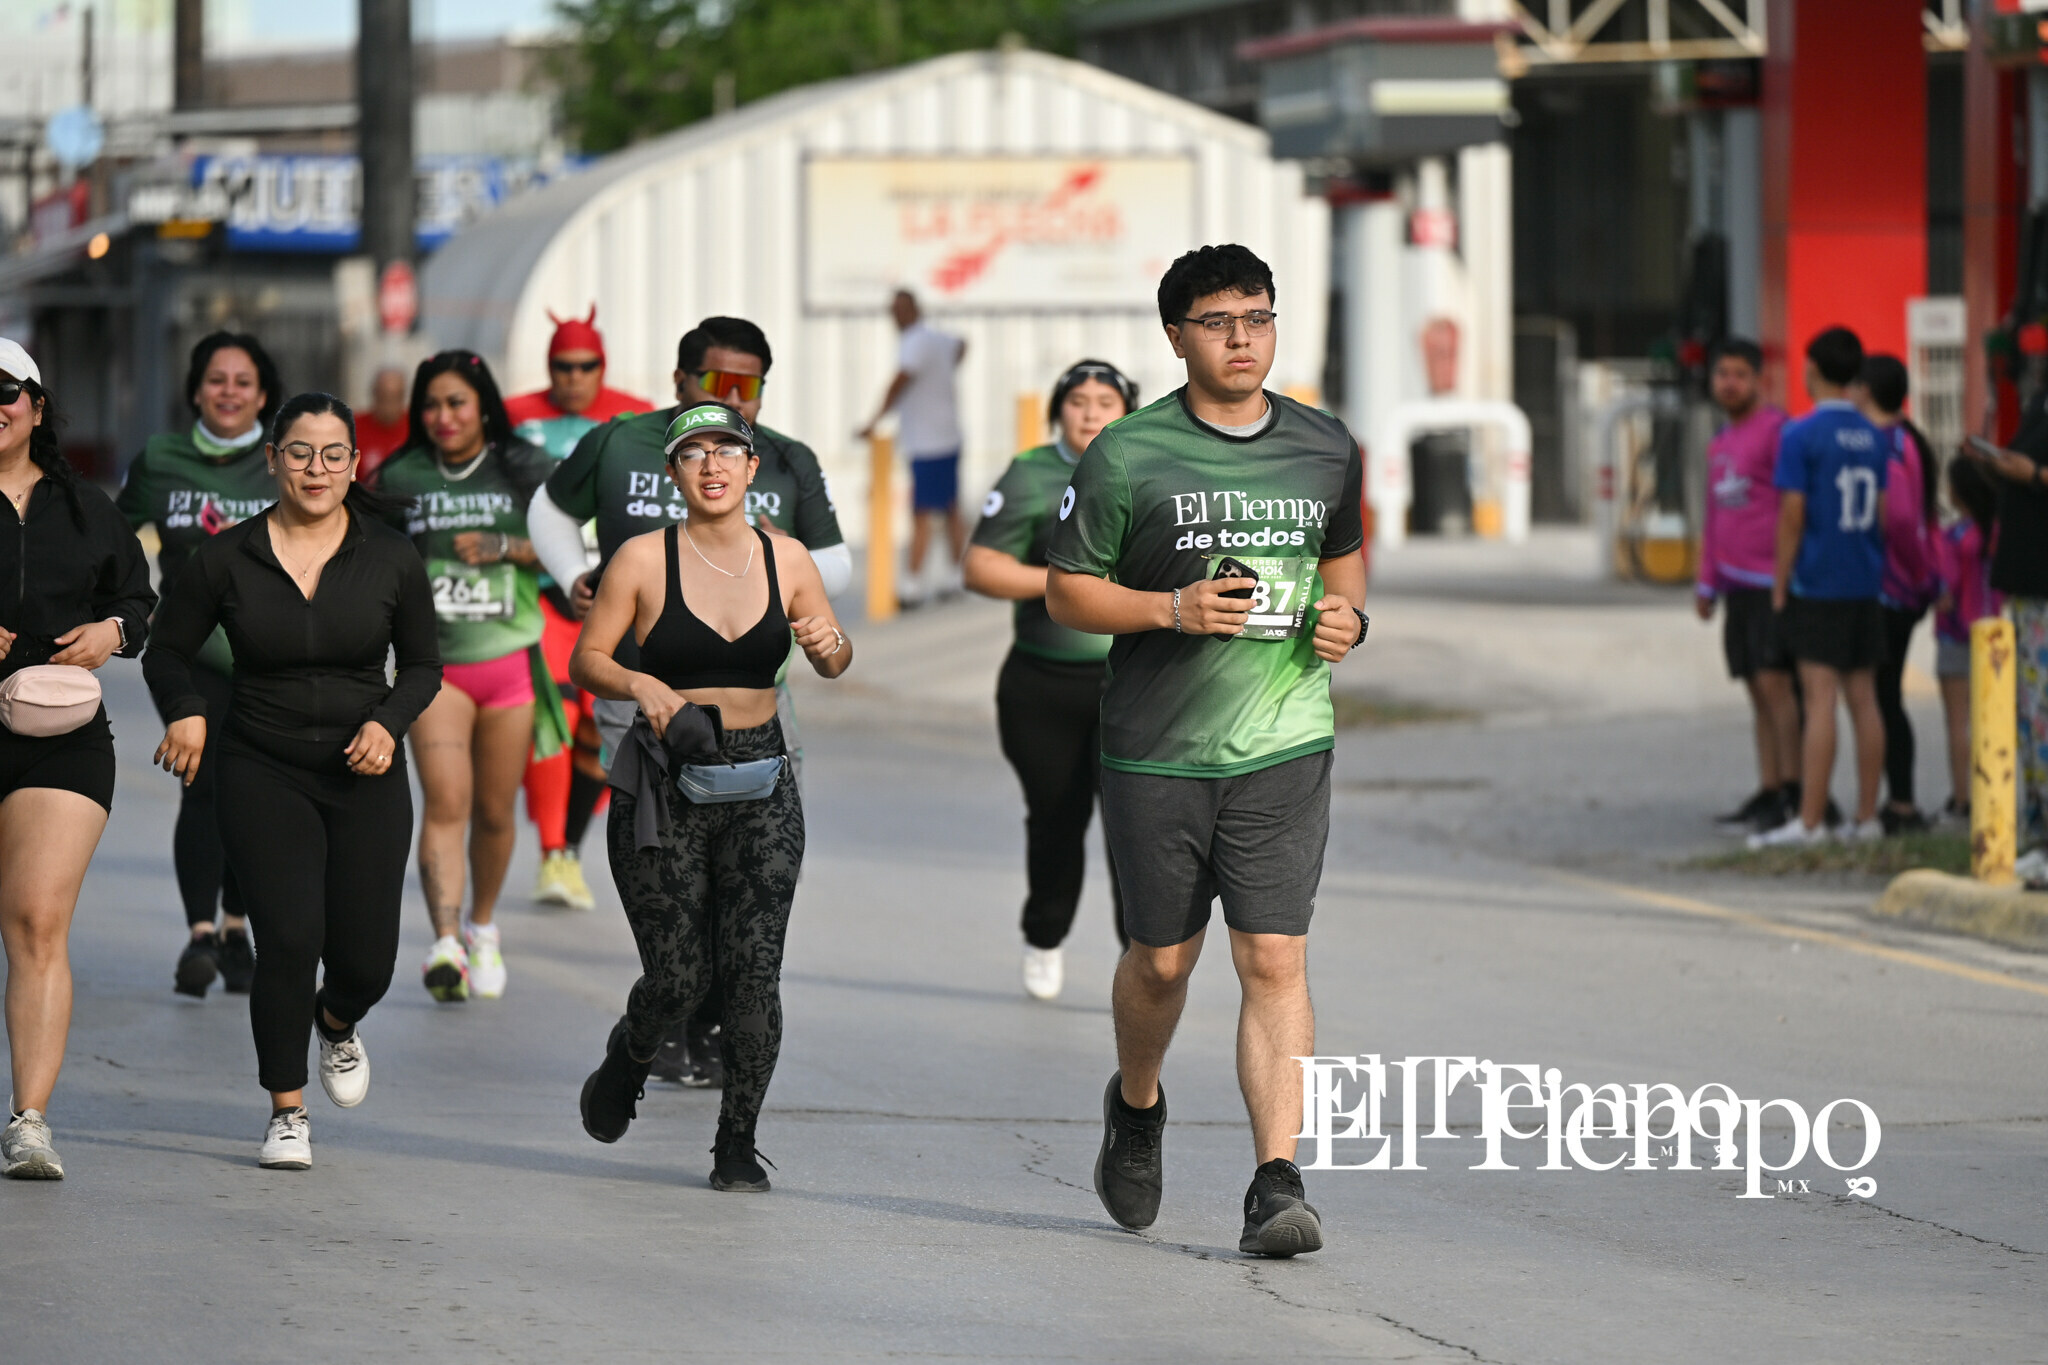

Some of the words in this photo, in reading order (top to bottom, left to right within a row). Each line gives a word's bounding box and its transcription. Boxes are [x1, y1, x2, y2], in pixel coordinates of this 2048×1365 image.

[627, 471, 660, 498] El
[1835, 465, 1878, 532] 10
[626, 499, 662, 518] de
[1170, 491, 1210, 526] El
[1213, 490, 1326, 528] Tiempo
[1175, 530, 1213, 550] de
[1218, 526, 1305, 548] todos
[433, 575, 490, 603] 264
[1249, 580, 1296, 613] 87
[1294, 576, 1313, 628] MEDALLA
